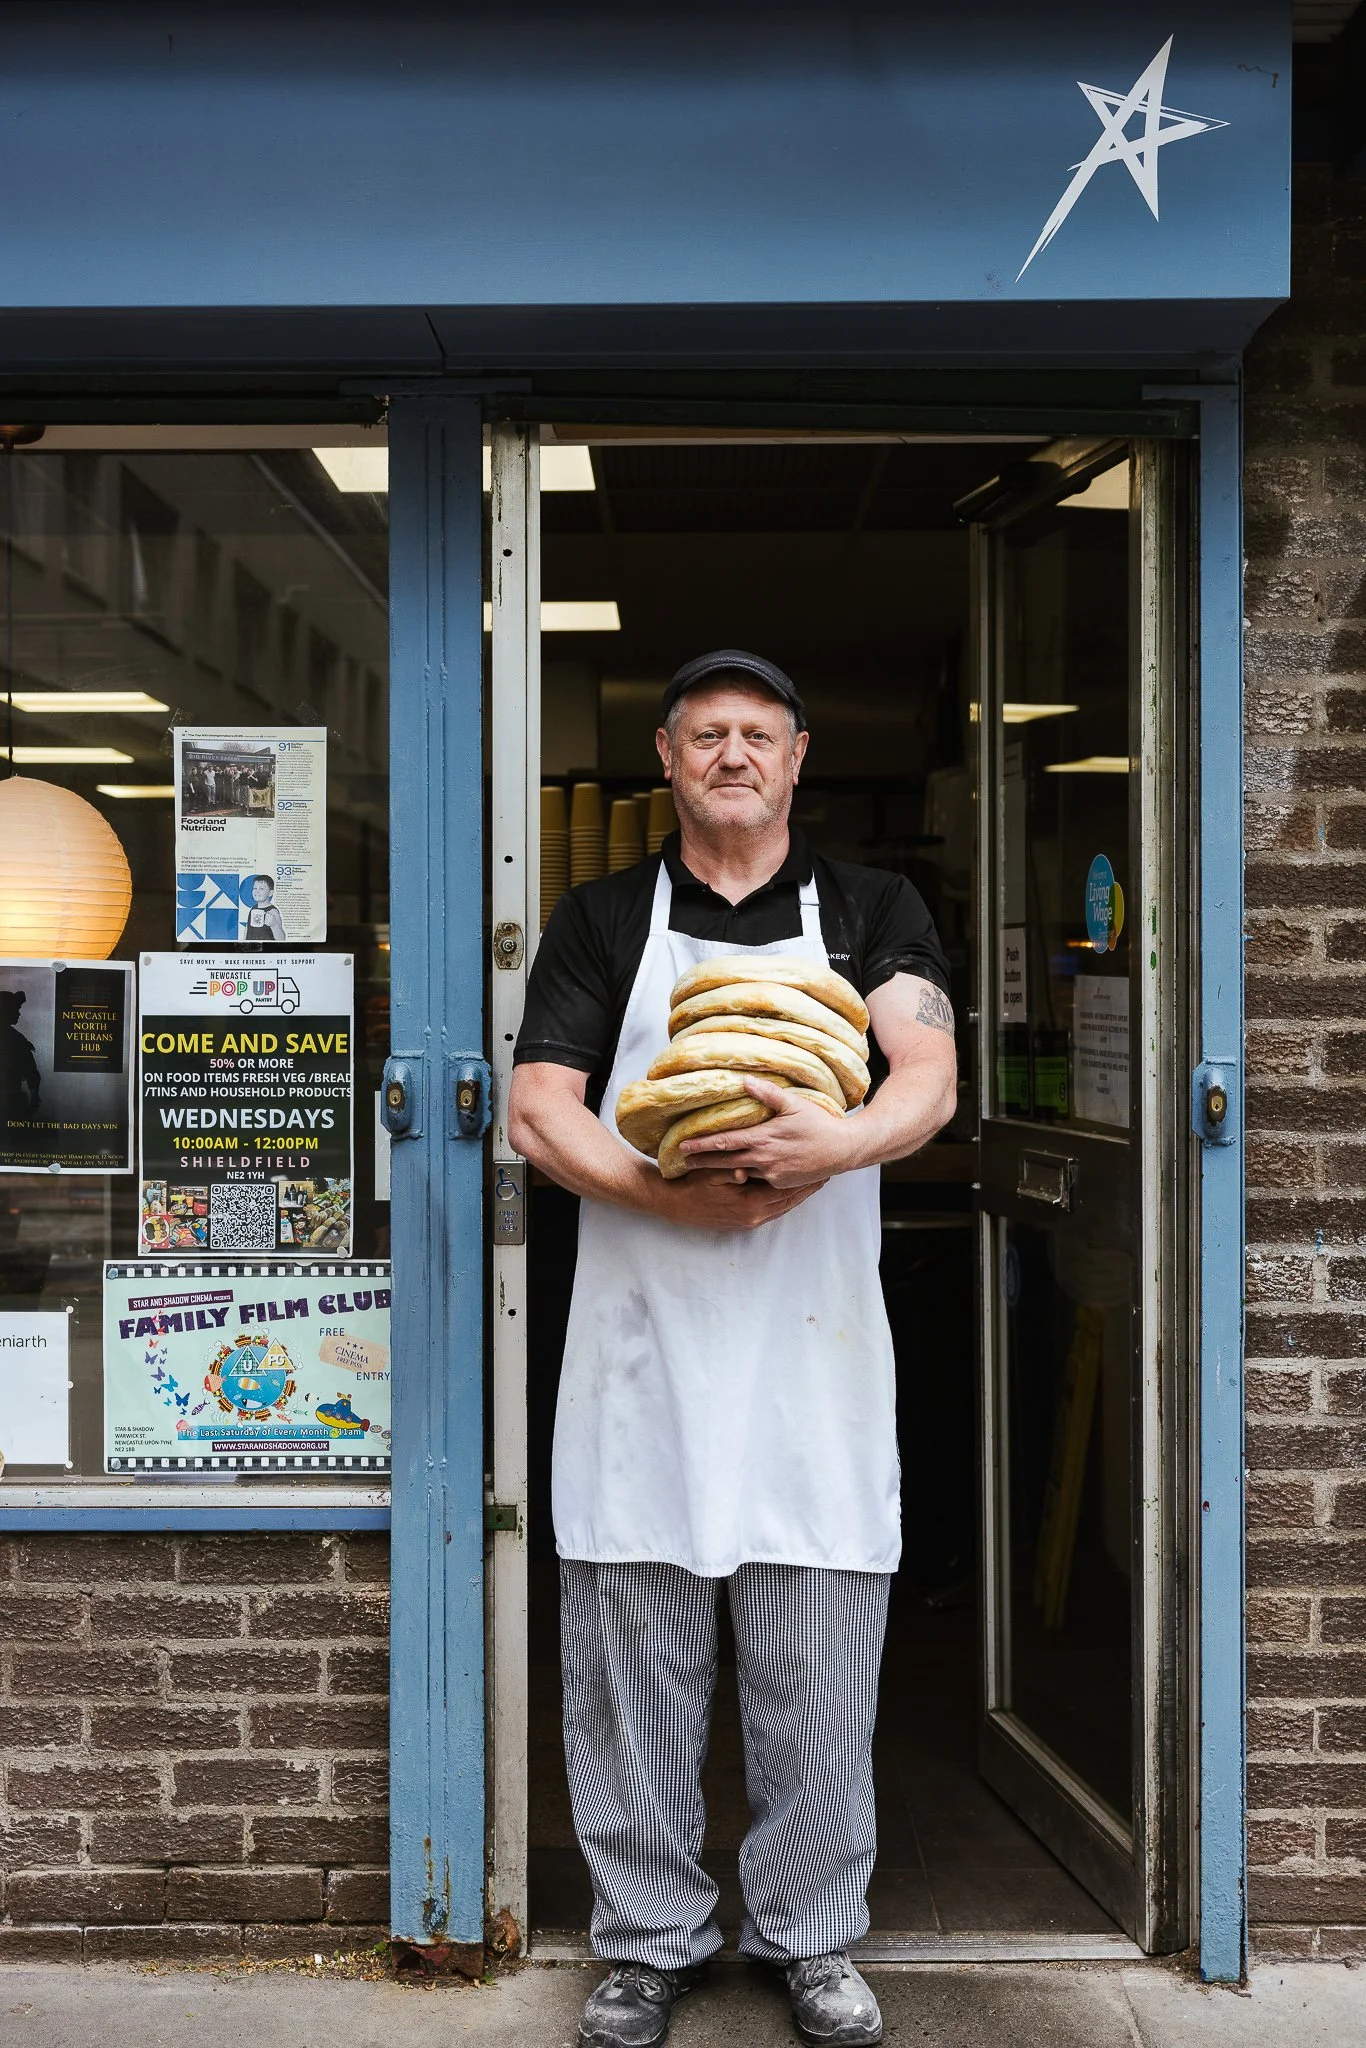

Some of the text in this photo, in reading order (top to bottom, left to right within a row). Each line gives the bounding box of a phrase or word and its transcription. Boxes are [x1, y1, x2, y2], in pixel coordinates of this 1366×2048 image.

[278, 742, 290, 751] 91
[278, 802, 292, 810] 92
[276, 866, 292, 875] 93
[1088, 882, 1110, 903] Living
[1092, 903, 1112, 926] Wage
[1006, 947, 1019, 962] Push
[1005, 968, 1021, 983] button
[210, 981, 275, 996] POP UP
[1010, 992, 1022, 1006] open
[62, 1012, 117, 1020] NEWCASTLE
[66, 1033, 113, 1042] VETERANS
[142, 1033, 348, 1054] COME AND SAVE
[81, 1044, 100, 1052] HUB
[210, 1058, 294, 1068] 50% OR MORE
[144, 1073, 162, 1082] ON
[167, 1073, 200, 1082] FOOD
[204, 1073, 239, 1082] ITEMS
[243, 1073, 279, 1082] FRESH
[283, 1073, 306, 1082] VEG
[145, 1087, 352, 1098] /TINS AND HOUSEHOLD PRODUCTS
[160, 1108, 334, 1129] WEDNESDAYS
[173, 1137, 238, 1150] 10:00AM
[254, 1137, 318, 1150] 12:00PM
[180, 1157, 310, 1168] SHIELDFIELD
[133, 1300, 149, 1308] STAR
[150, 1299, 163, 1307] AND
[164, 1296, 190, 1306] SHADOW
[191, 1294, 212, 1303] CINEMA
[119, 1288, 391, 1339] FAMILY FILM CLUB
[320, 1328, 345, 1336] FREE
[335, 1346, 369, 1363] CINEMA
[244, 1354, 286, 1372] U PG
[357, 1372, 390, 1380] ENTRY
[221, 1428, 259, 1437] Saturday
[274, 1429, 296, 1437] Every
